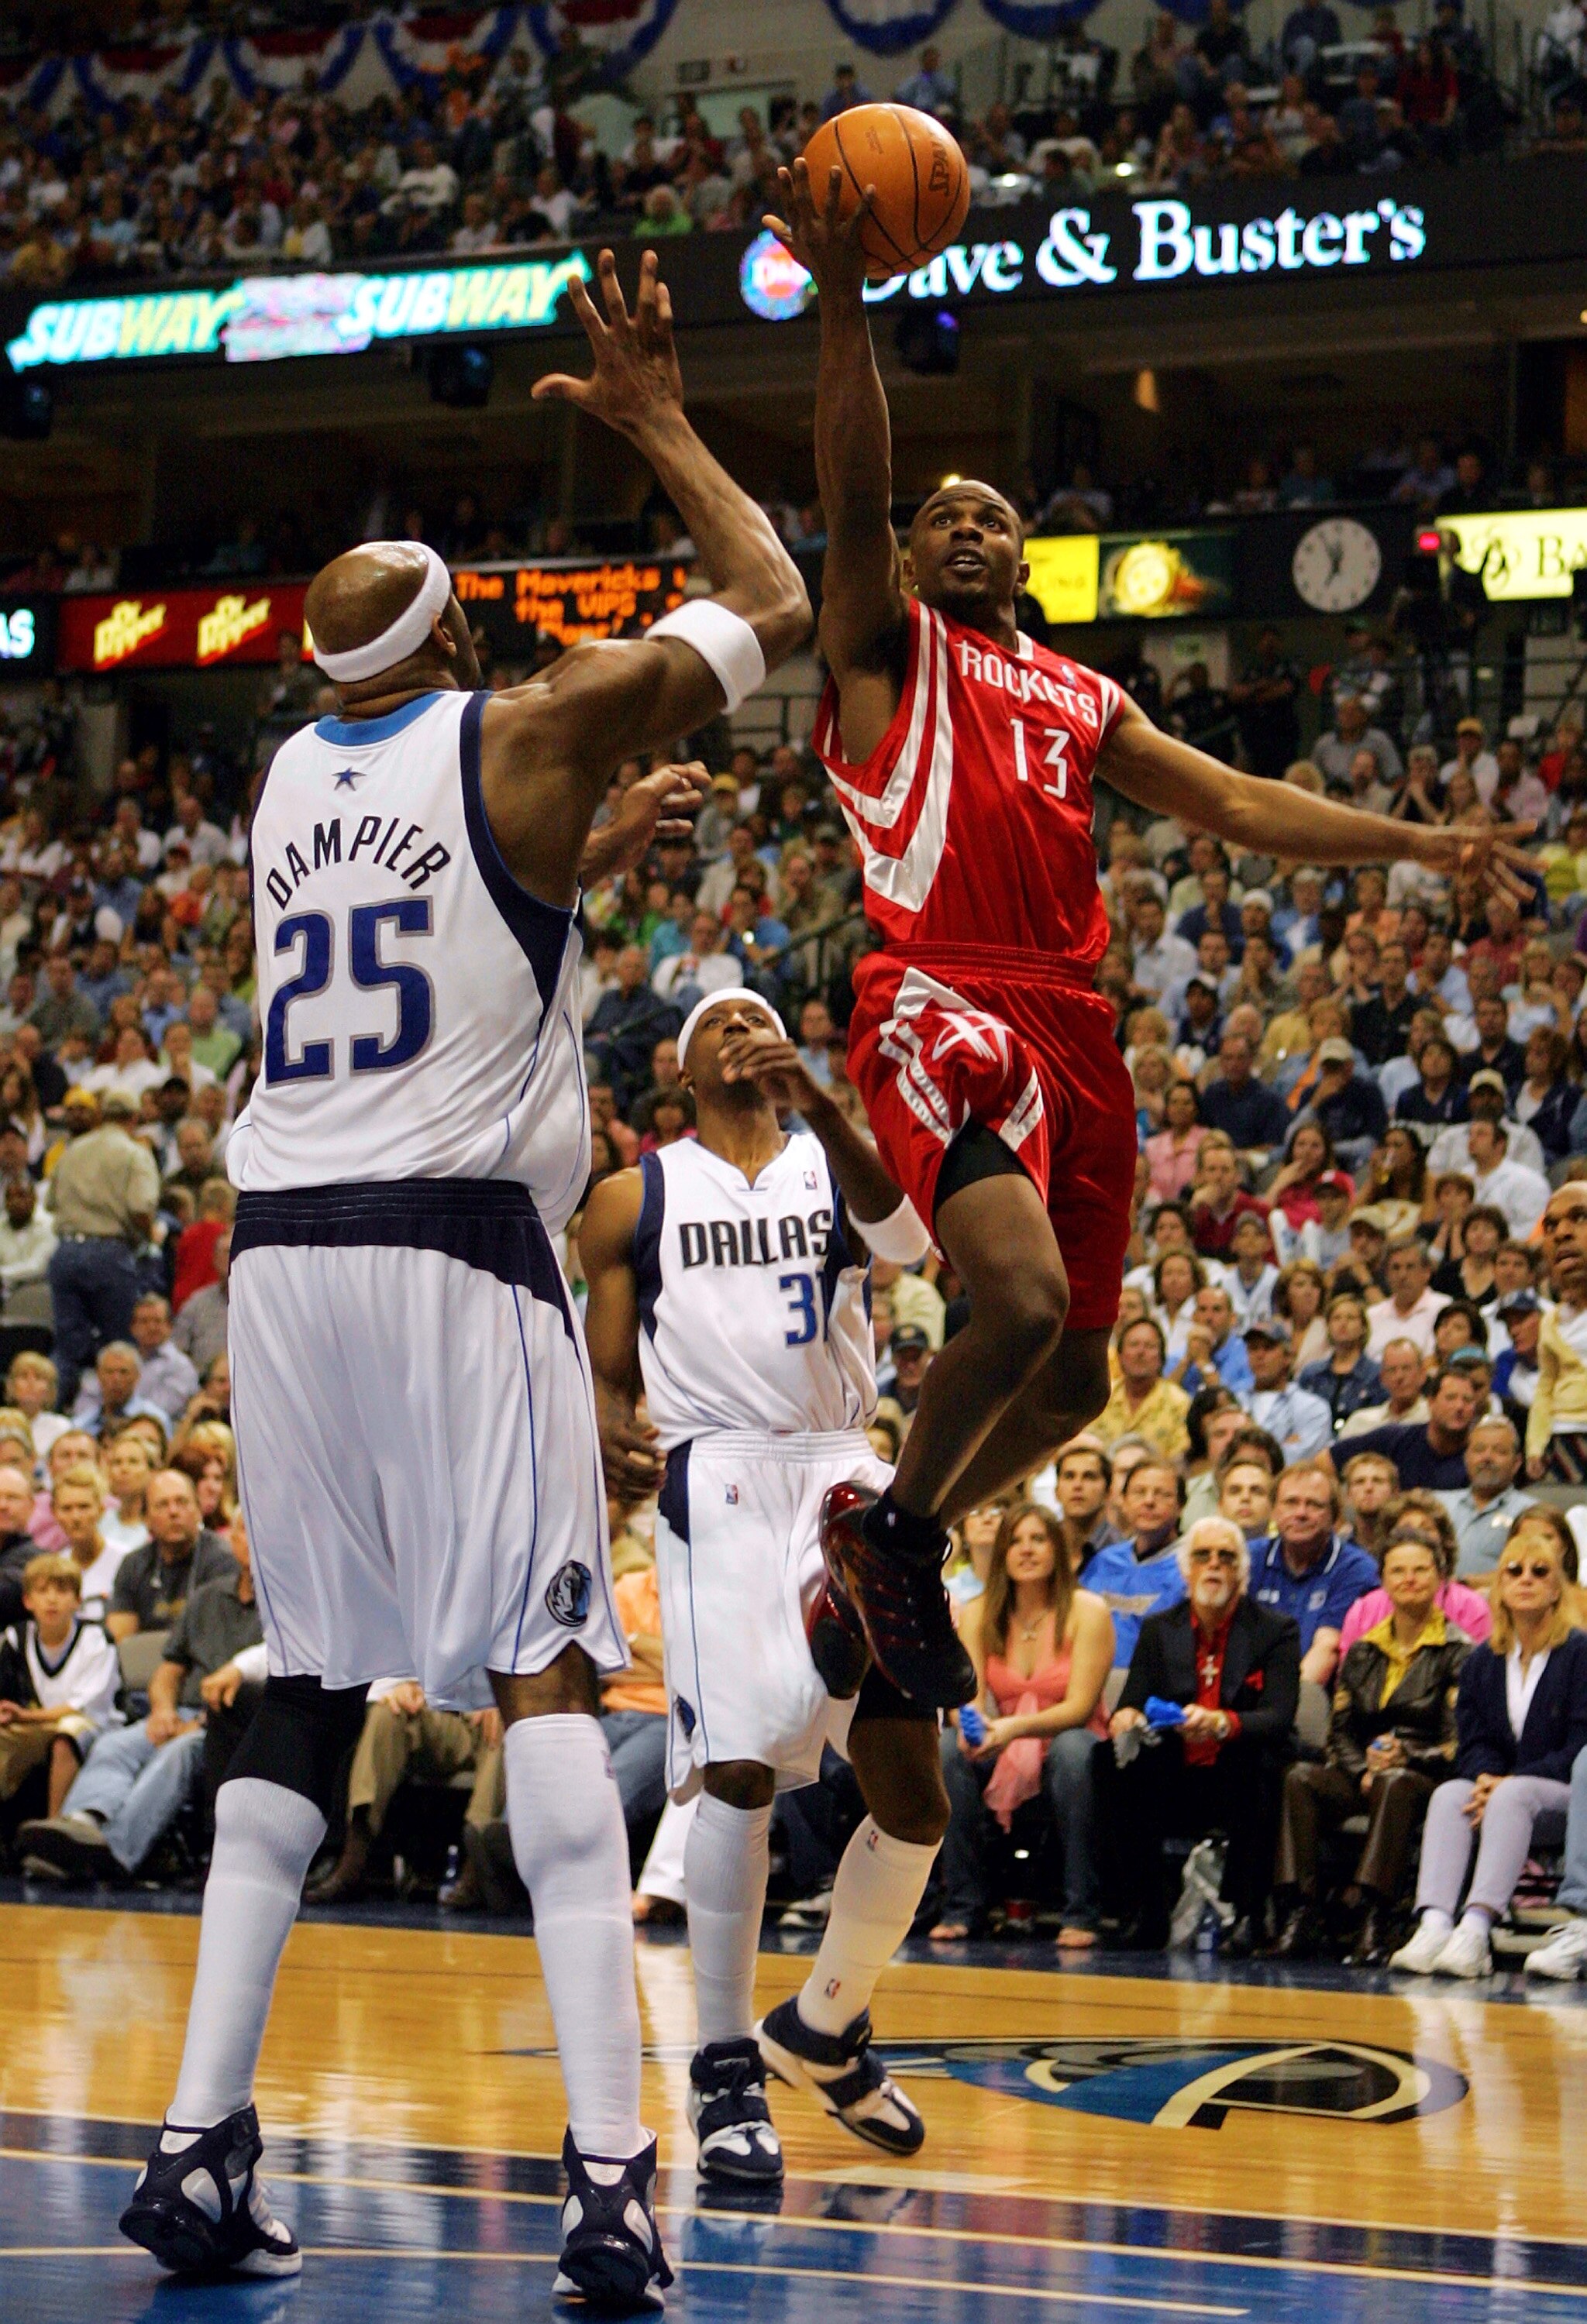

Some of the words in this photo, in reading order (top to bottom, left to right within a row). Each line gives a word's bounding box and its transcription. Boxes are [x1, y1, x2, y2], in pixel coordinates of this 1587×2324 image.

[1035, 207, 1117, 287] &
[1132, 198, 1427, 280] Buster's
[6, 279, 246, 372] SUBWAY
[333, 249, 592, 339] SUBWAY
[955, 640, 1097, 728] ROCKETS
[1010, 718, 1070, 799] 13
[266, 816, 451, 909] DAMPIER
[266, 896, 433, 1089] 25
[679, 1209, 831, 1269] DALLAS
